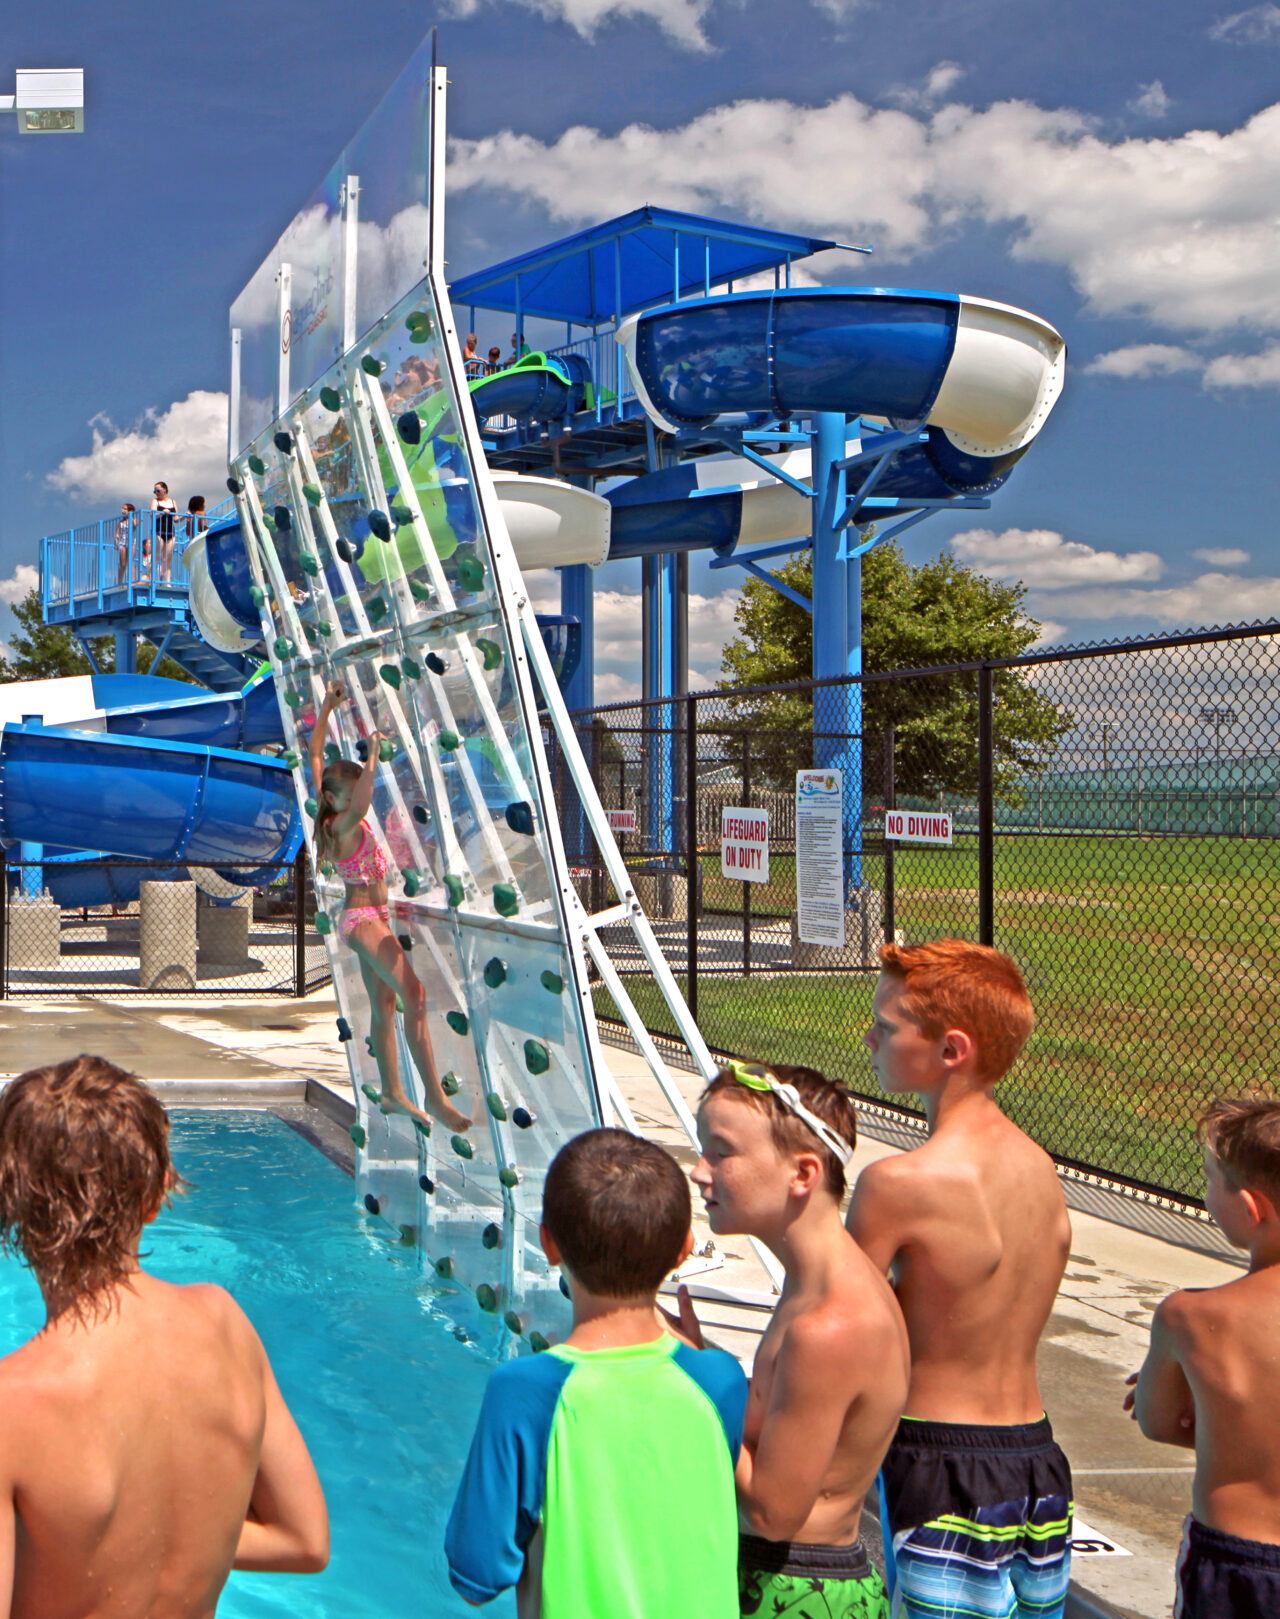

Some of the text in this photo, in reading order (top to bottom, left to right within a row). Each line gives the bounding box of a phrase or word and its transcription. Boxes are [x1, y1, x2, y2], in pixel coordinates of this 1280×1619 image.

[611, 812, 635, 828] RUNNING
[722, 818, 767, 842] LIFEGUARD
[888, 815, 949, 838] NO DIVING
[725, 845, 762, 870] ON DUTY
